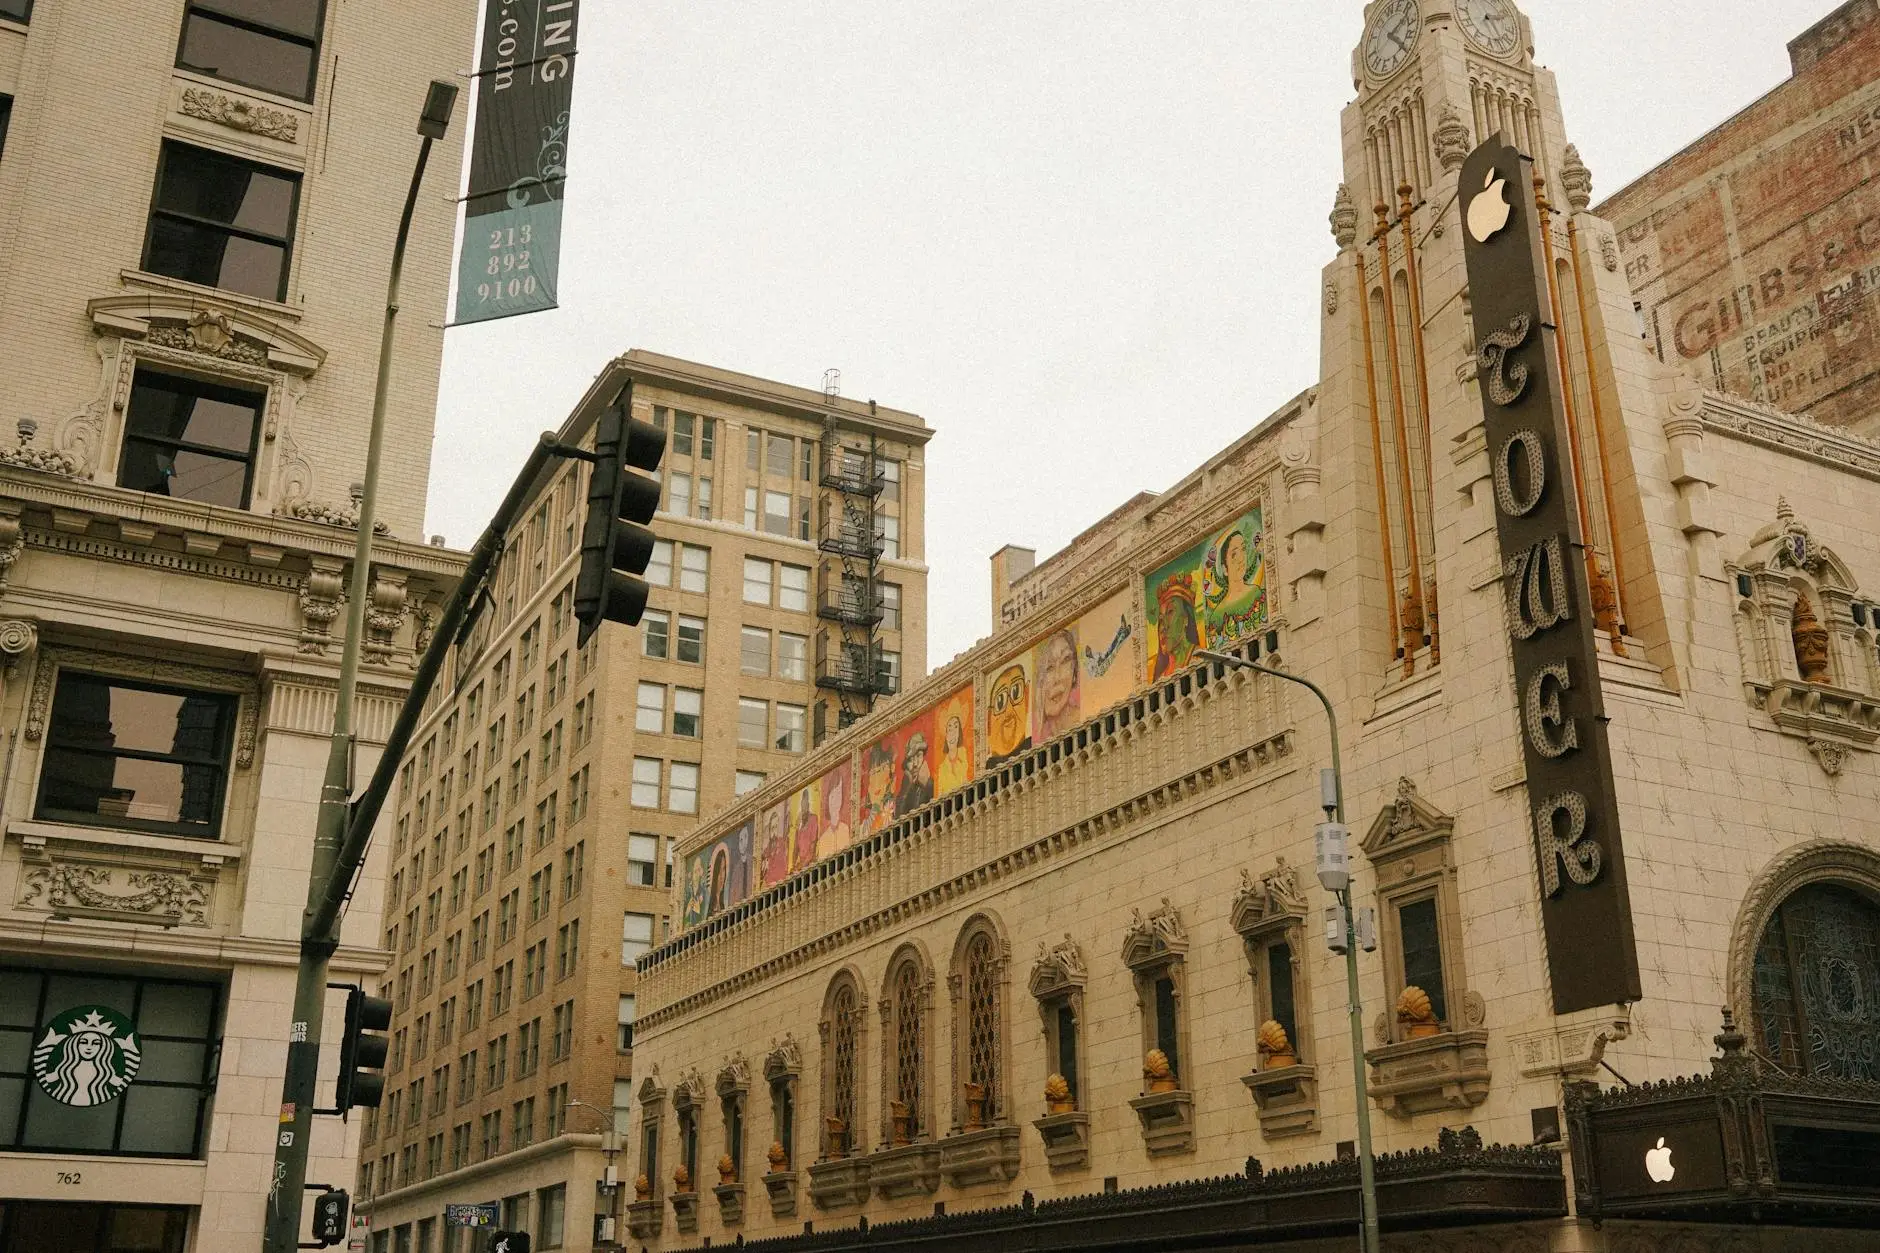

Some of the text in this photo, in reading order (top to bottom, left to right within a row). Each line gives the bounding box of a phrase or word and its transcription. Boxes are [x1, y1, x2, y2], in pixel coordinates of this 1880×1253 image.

[540, 1, 573, 83] ING
[490, 224, 532, 250] 213
[487, 250, 530, 276] 892
[477, 275, 537, 304] 9100
[1674, 251, 1814, 360] GIBBS
[1743, 304, 1814, 353] BEAUTY
[1477, 310, 1601, 900] TOWER
[56, 1172, 81, 1185] 762
